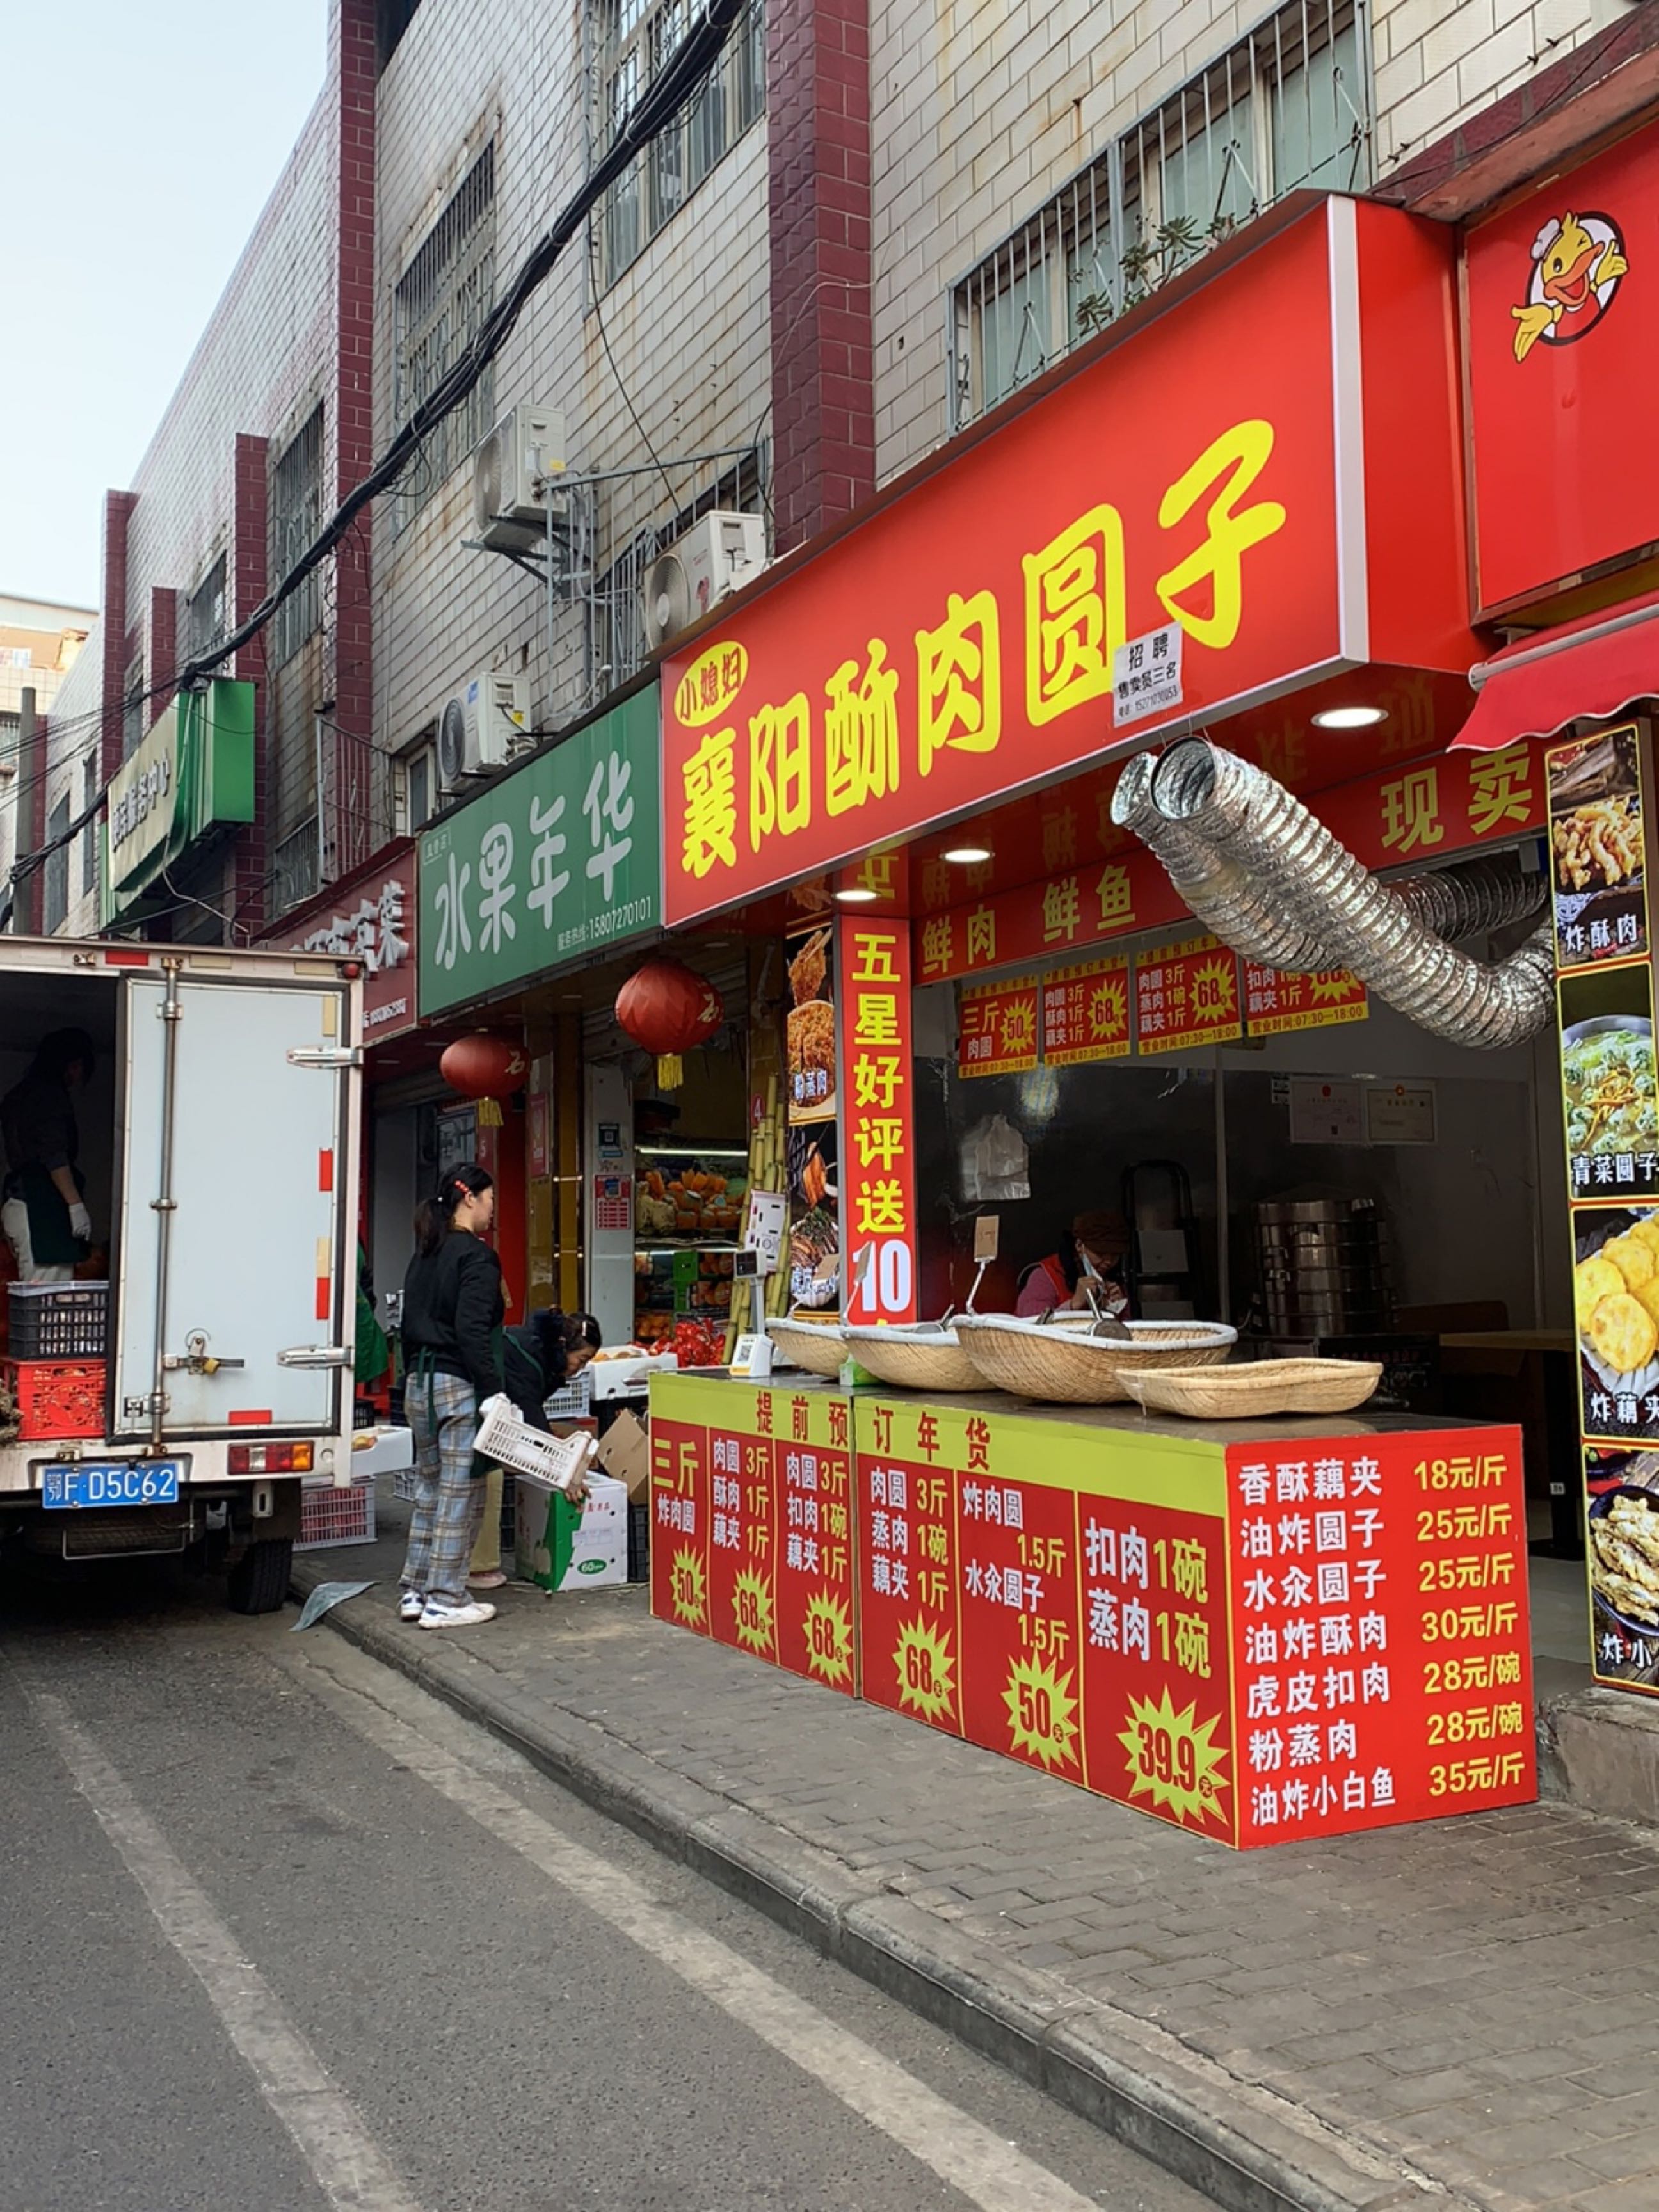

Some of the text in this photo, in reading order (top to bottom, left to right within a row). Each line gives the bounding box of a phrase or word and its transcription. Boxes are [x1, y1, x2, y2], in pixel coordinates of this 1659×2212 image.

[682, 419, 1286, 879] 襄阳酥肉圆子
[1129, 632, 1168, 671] 招聘
[680, 646, 741, 720] 小媳妇
[1381, 743, 1532, 853] 现卖
[435, 751, 634, 970] 水果年华
[922, 865, 1135, 974] 鲜肉 鲜鱼
[1564, 913, 1637, 953] 炸酥肉
[1068, 983, 1084, 1002] 3斤
[1166, 963, 1185, 984] 3斤
[1248, 967, 1275, 990] 扣肉
[1281, 985, 1302, 1006] 1斤
[963, 1001, 1000, 1034] 三斤
[1068, 1004, 1084, 1022] 1斤
[1068, 1024, 1084, 1042] 1斤
[1166, 1007, 1185, 1027] 1斤
[852, 934, 911, 1326] 五星好评送10
[1571, 1152, 1659, 1185] 青菜圆子
[653, 1438, 699, 1498] 三斤
[713, 1438, 769, 1479] 肉圆 3斤
[787, 1452, 847, 1498] 肉圆 3斤
[1239, 1455, 1507, 1505] 香酥藕夹 18元/斤
[657, 1494, 695, 1534] 炸肉圆
[713, 1475, 769, 1519] 酥肉 1斤
[787, 1491, 847, 1541] 扣肉 1碗
[870, 1466, 947, 1518] 肉圆 3斤
[963, 1481, 1023, 1530] 炸肉圆
[713, 1512, 769, 1559] 藕夹 1斤
[871, 1511, 949, 1566] 蒸肉 1碗
[1018, 1534, 1066, 1578] 1.5斤
[1240, 1503, 1512, 1559] 油炸圆子 25元/斤
[787, 1533, 847, 1583] 藕夹 1斤
[872, 1553, 949, 1612] 藕夹 1斤
[1085, 1516, 1208, 1604] 扣肉 1碗
[1418, 1553, 1516, 1592] 25元/斤
[1018, 1613, 1069, 1660] 1.5斤
[1089, 1587, 1212, 1679] 蒸肉 1碗
[1245, 1602, 1519, 1664] 油炸酥肉 30元/斤
[1247, 1651, 1521, 1719] 虎皮扣肉 28元/碗
[1138, 1722, 1213, 1799] 39.9元
[1248, 1702, 1523, 1772] 粉蒸肉 28元/碗
[1251, 1752, 1525, 1827] 油炸小白鱼 35元/斤
